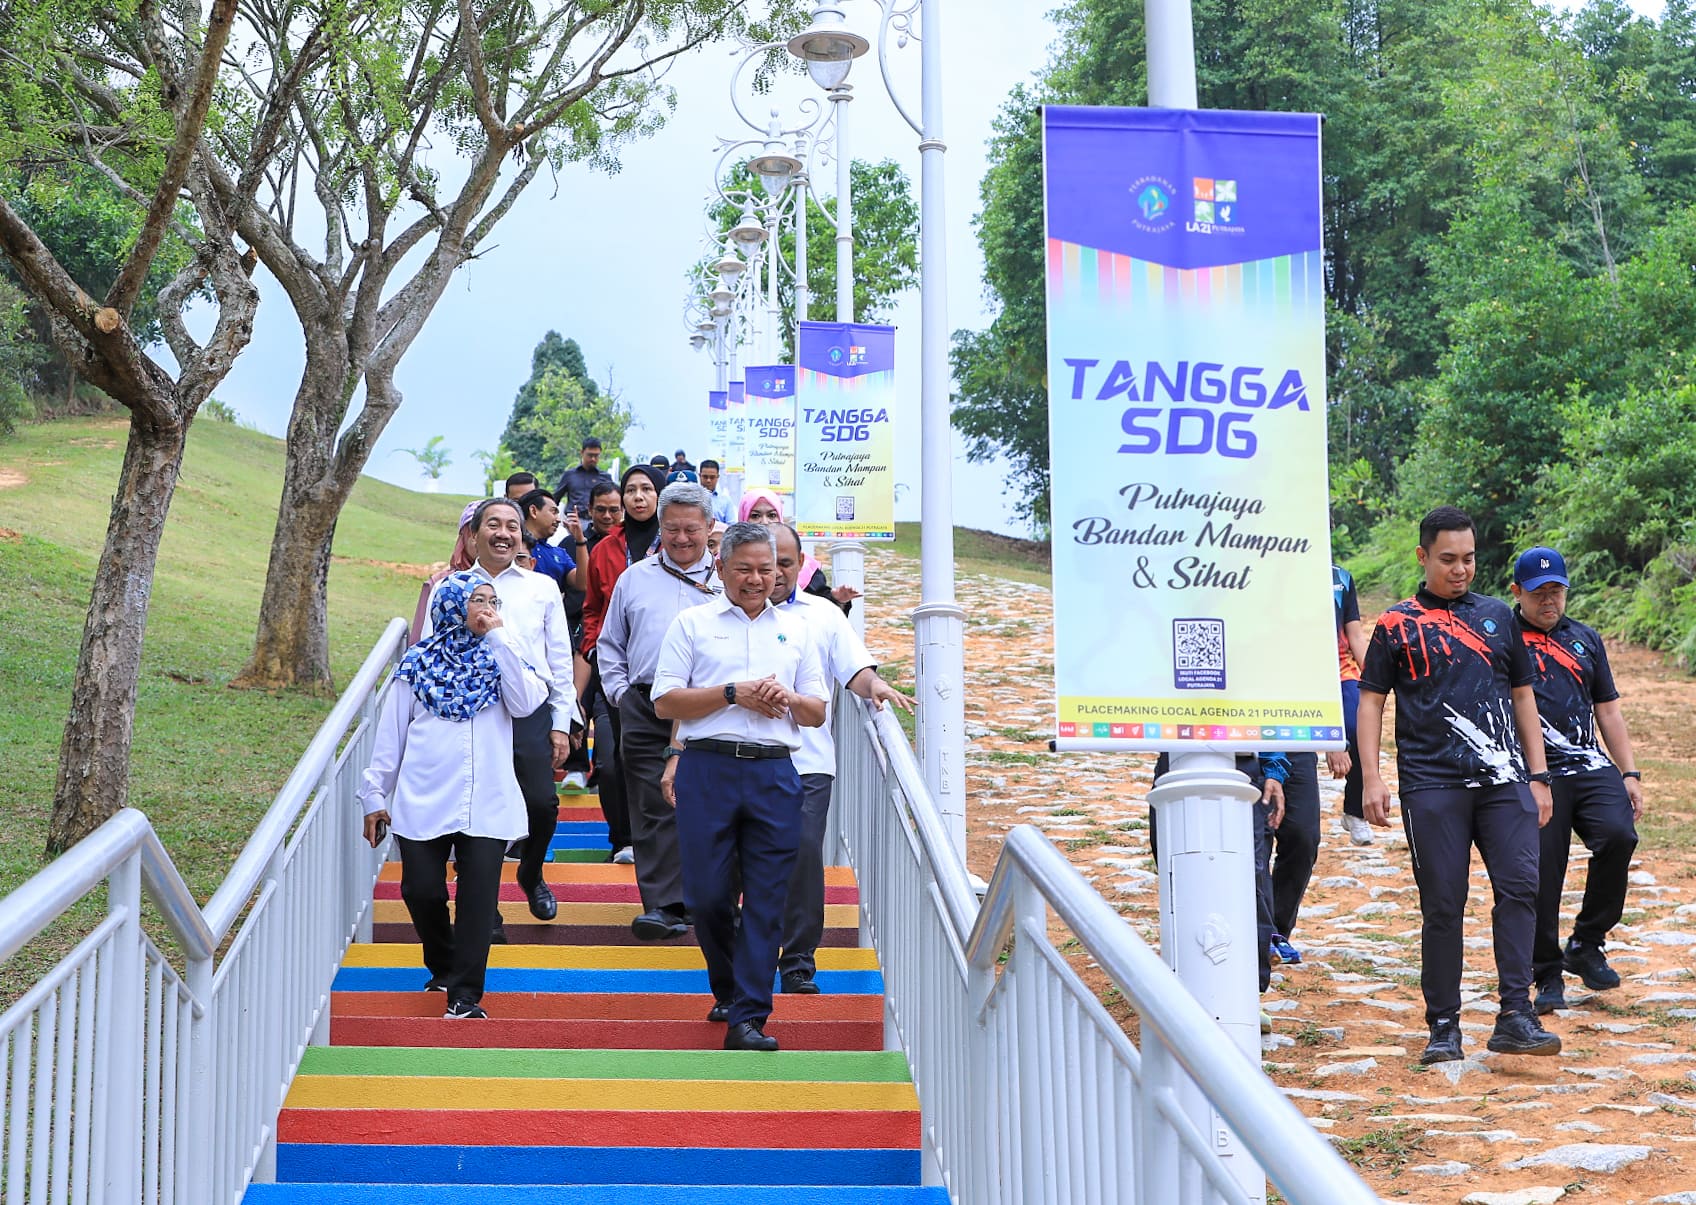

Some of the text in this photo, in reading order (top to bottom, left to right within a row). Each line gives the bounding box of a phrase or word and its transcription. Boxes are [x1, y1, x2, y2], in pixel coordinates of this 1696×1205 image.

[1063, 358, 1310, 412] TANGGA
[803, 408, 889, 424] TANGGA
[759, 427, 789, 438] SDG
[820, 424, 870, 442] SDG
[1117, 407, 1258, 459] SDG
[820, 451, 871, 463] Putrajaya
[803, 462, 887, 474] Bandar Mampan
[823, 475, 866, 487] & Sihat
[1119, 482, 1266, 520] Putrajaya
[1072, 517, 1312, 558] Bandar Mampan
[1132, 555, 1252, 590] & Sihat
[1077, 704, 1323, 720] PLACEMAKING LOCAL AGENDA 21 PUTRAJAYA
